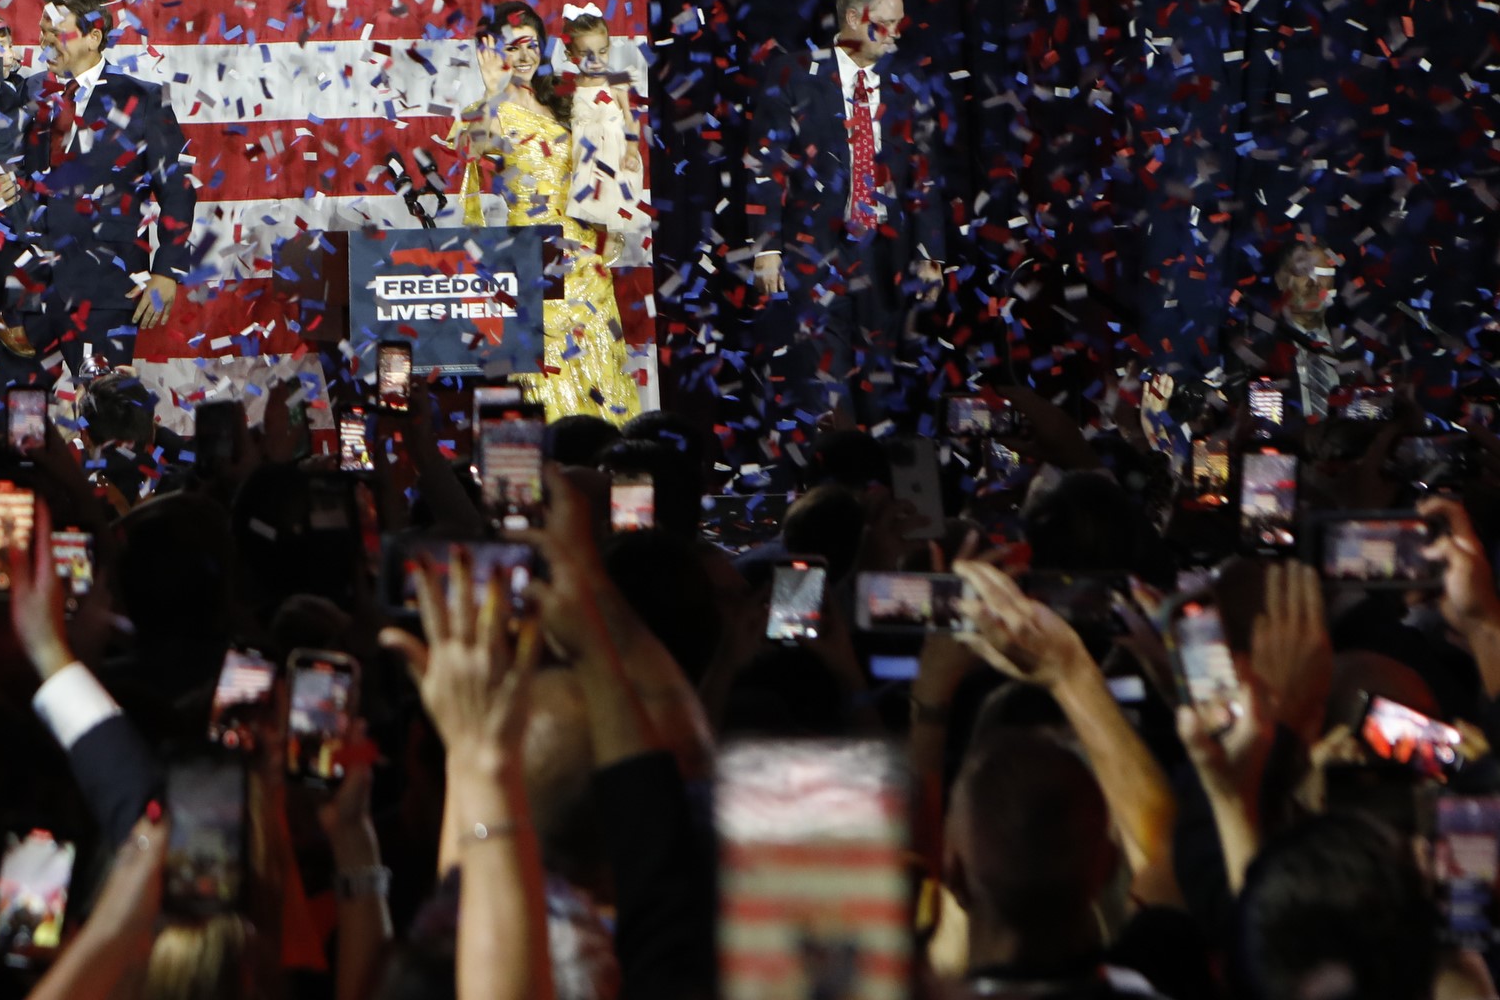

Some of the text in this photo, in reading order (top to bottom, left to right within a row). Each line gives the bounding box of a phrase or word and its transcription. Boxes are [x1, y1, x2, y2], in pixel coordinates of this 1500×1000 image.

[384, 278, 509, 295] FREEDOM
[377, 302, 518, 321] LIVES HERE
